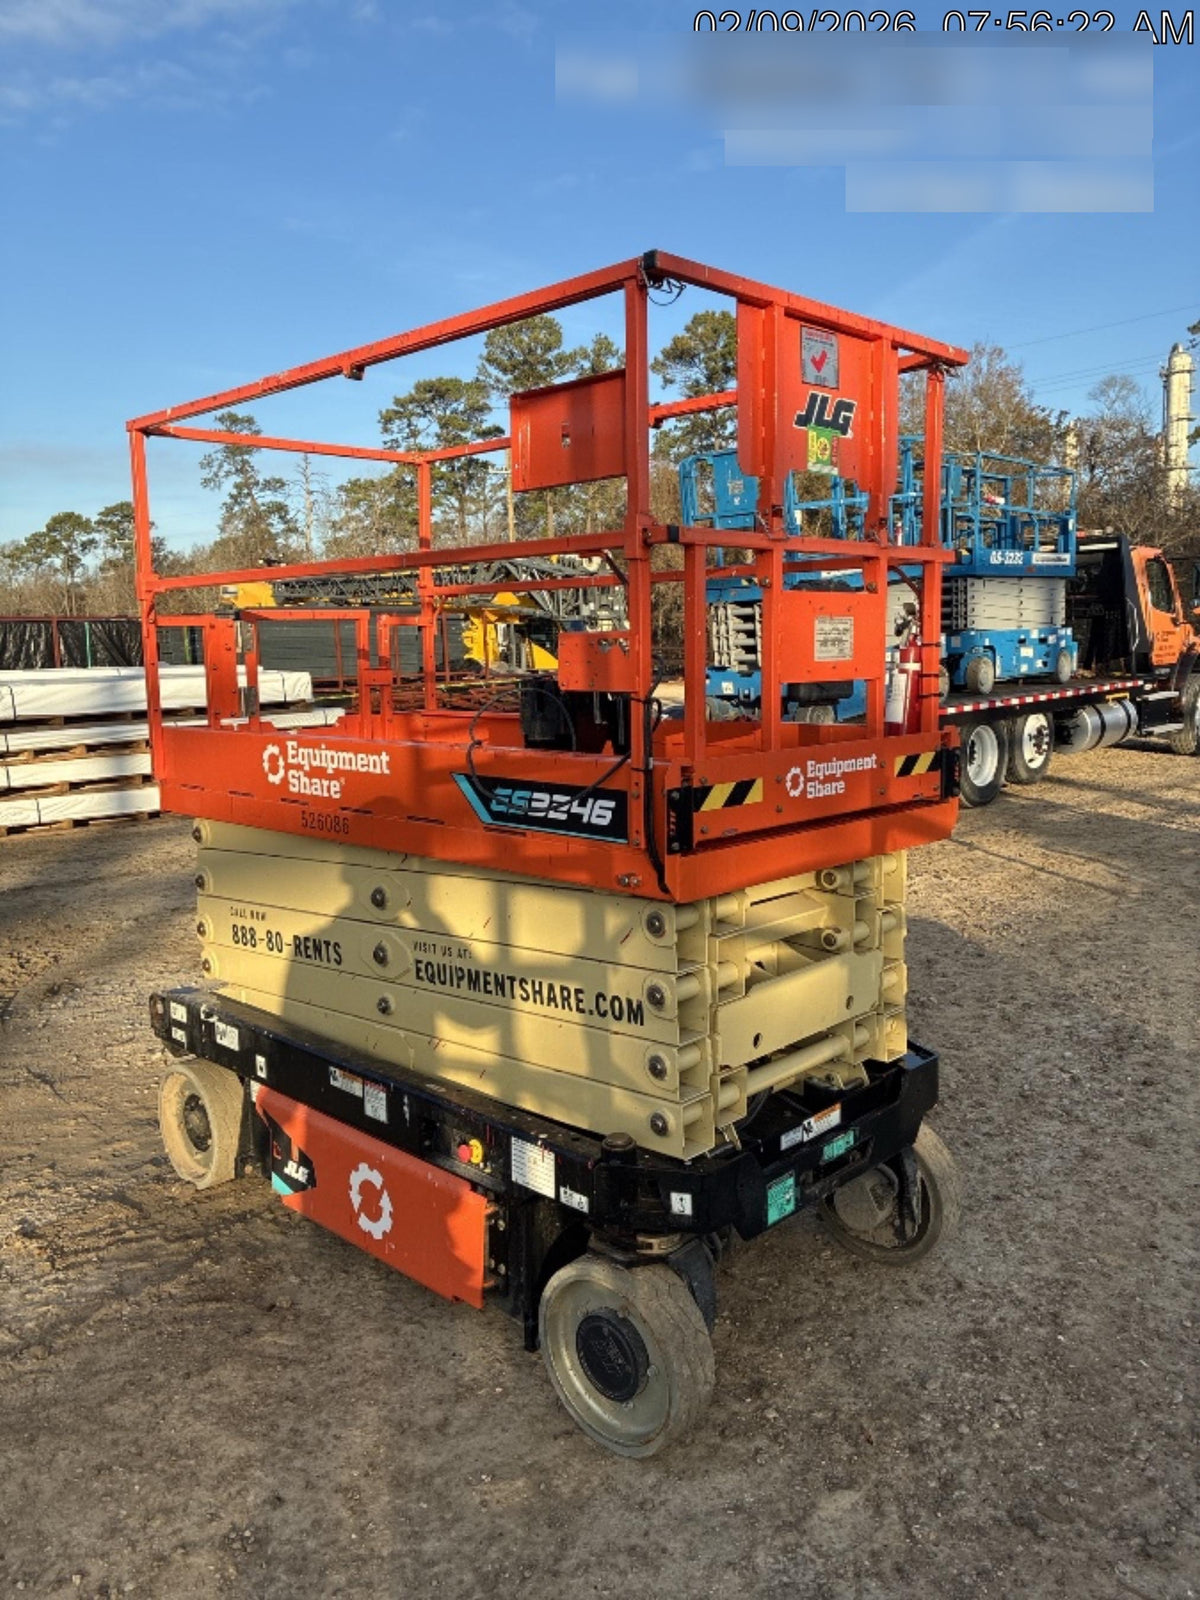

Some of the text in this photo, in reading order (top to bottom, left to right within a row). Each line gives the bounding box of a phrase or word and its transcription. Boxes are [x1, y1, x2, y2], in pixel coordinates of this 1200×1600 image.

[793, 391, 857, 438] JLG
[286, 741, 390, 774] Equipment
[806, 753, 878, 780] Equipment
[288, 770, 342, 799] Share
[806, 780, 846, 799] Share
[301, 811, 350, 835] 526086
[231, 924, 343, 966] 888-80-RENTS
[413, 941, 436, 955] VISIT
[441, 944, 453, 957] US
[414, 959, 645, 1027] EQUIPMENTSHARE.COM
